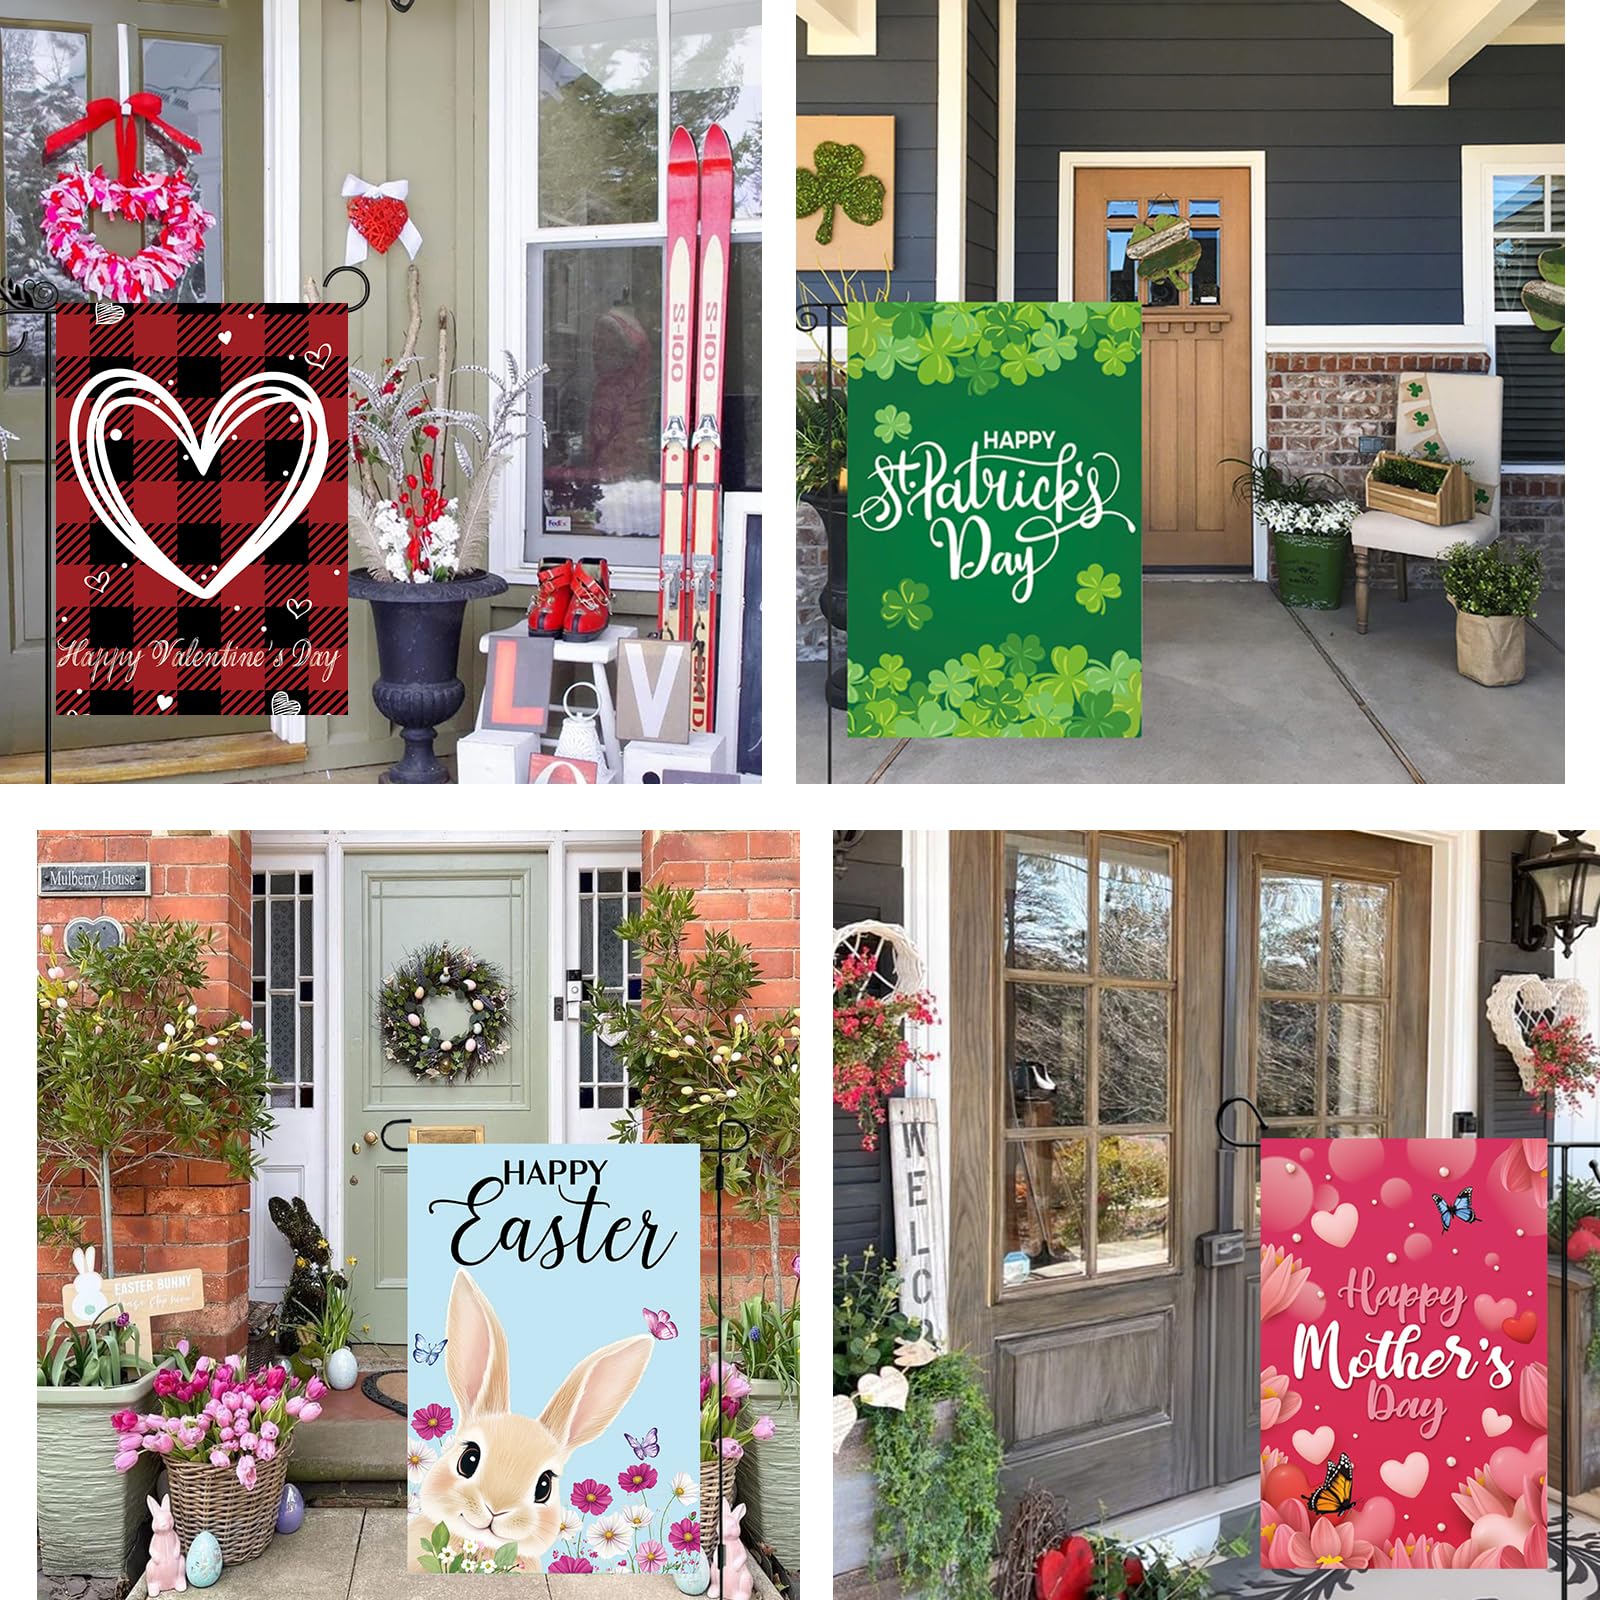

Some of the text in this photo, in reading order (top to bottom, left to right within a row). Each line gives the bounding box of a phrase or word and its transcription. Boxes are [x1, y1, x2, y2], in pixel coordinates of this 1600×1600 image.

[984, 430, 1056, 449] HAPPY
[929, 515, 1060, 603] Day
[56, 637, 342, 683] Happy Valentine's Day
[50, 869, 136, 889] Mulberry House
[503, 1160, 608, 1185] HAPPY
[429, 1176, 678, 1269] Easter
[114, 1273, 192, 1296] EASTER BUNNY
[1337, 1266, 1468, 1328] Happy
[1293, 1320, 1514, 1389] Mother's
[1367, 1379, 1448, 1440] Day
